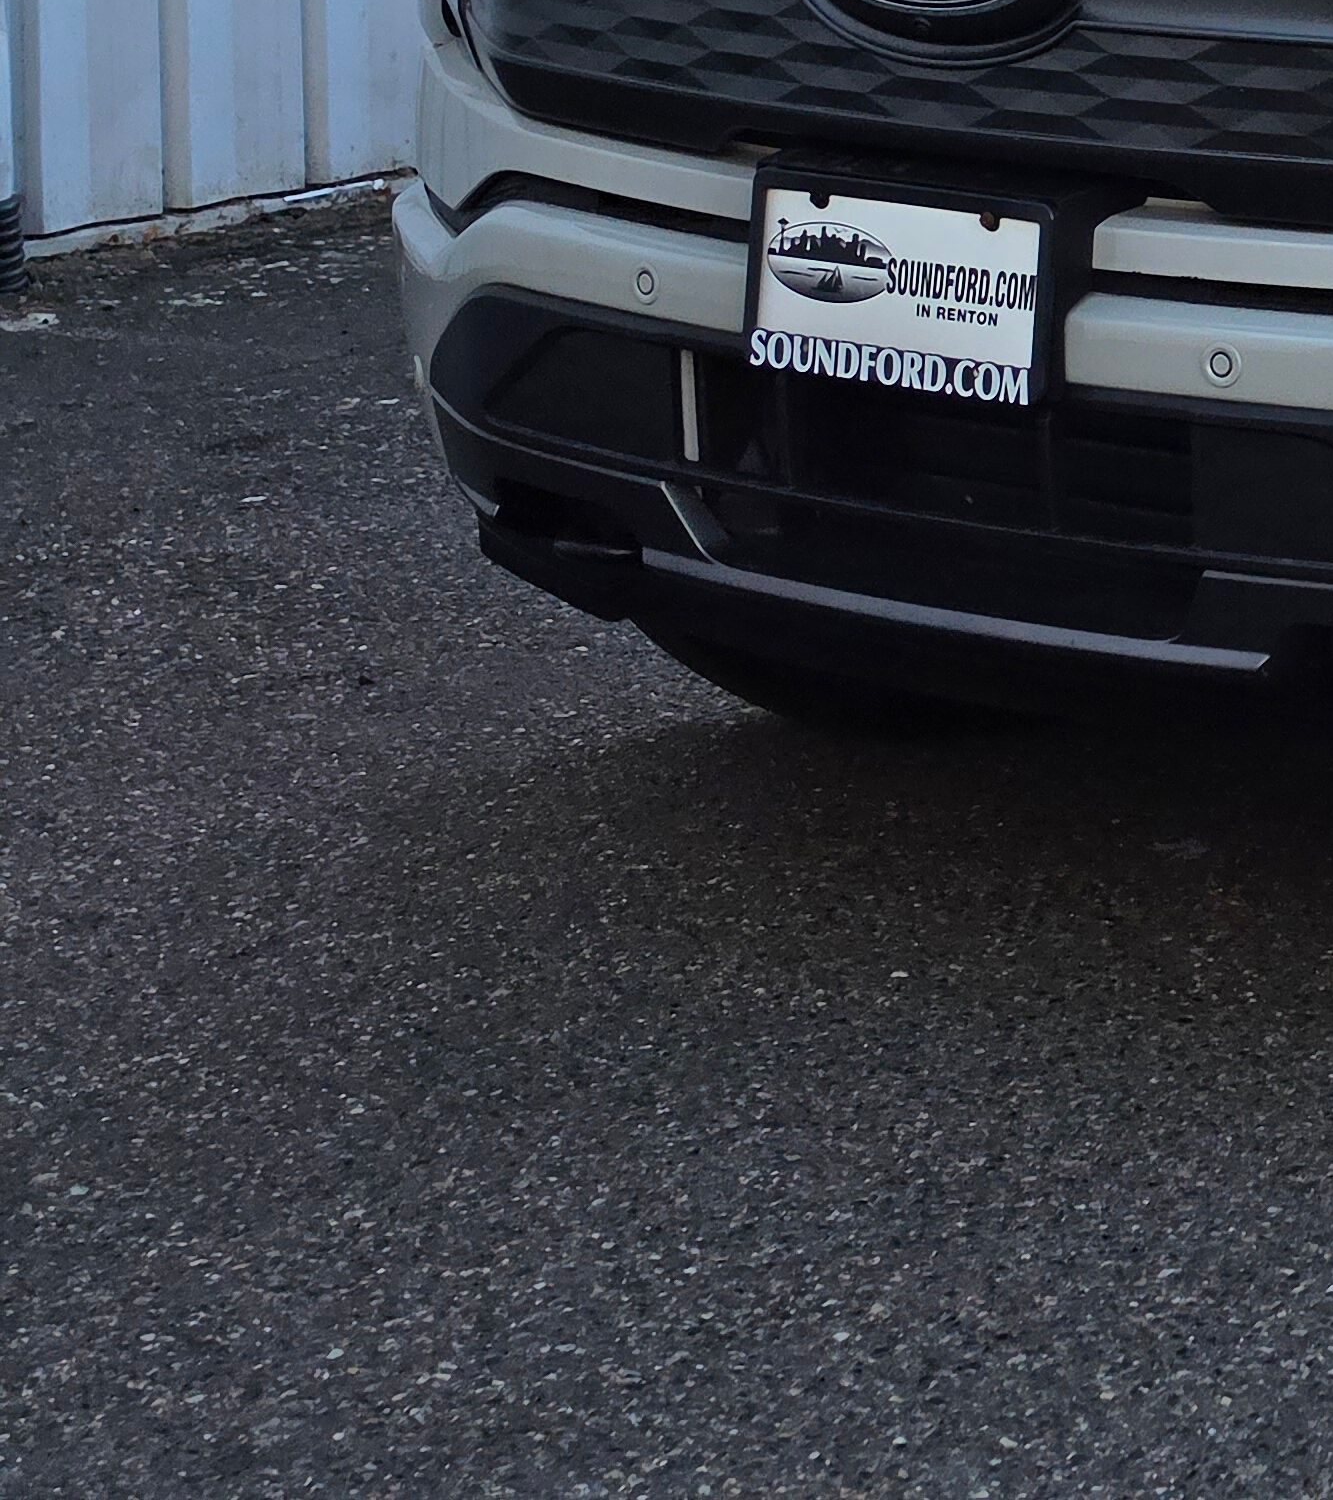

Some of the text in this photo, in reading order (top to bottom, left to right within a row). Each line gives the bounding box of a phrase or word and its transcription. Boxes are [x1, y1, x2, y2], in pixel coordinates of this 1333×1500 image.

[886, 257, 1037, 312] SOUNDFORD.COM
[916, 303, 998, 327] IN RENTON
[749, 329, 1029, 406] SOUNDFORD.COM
